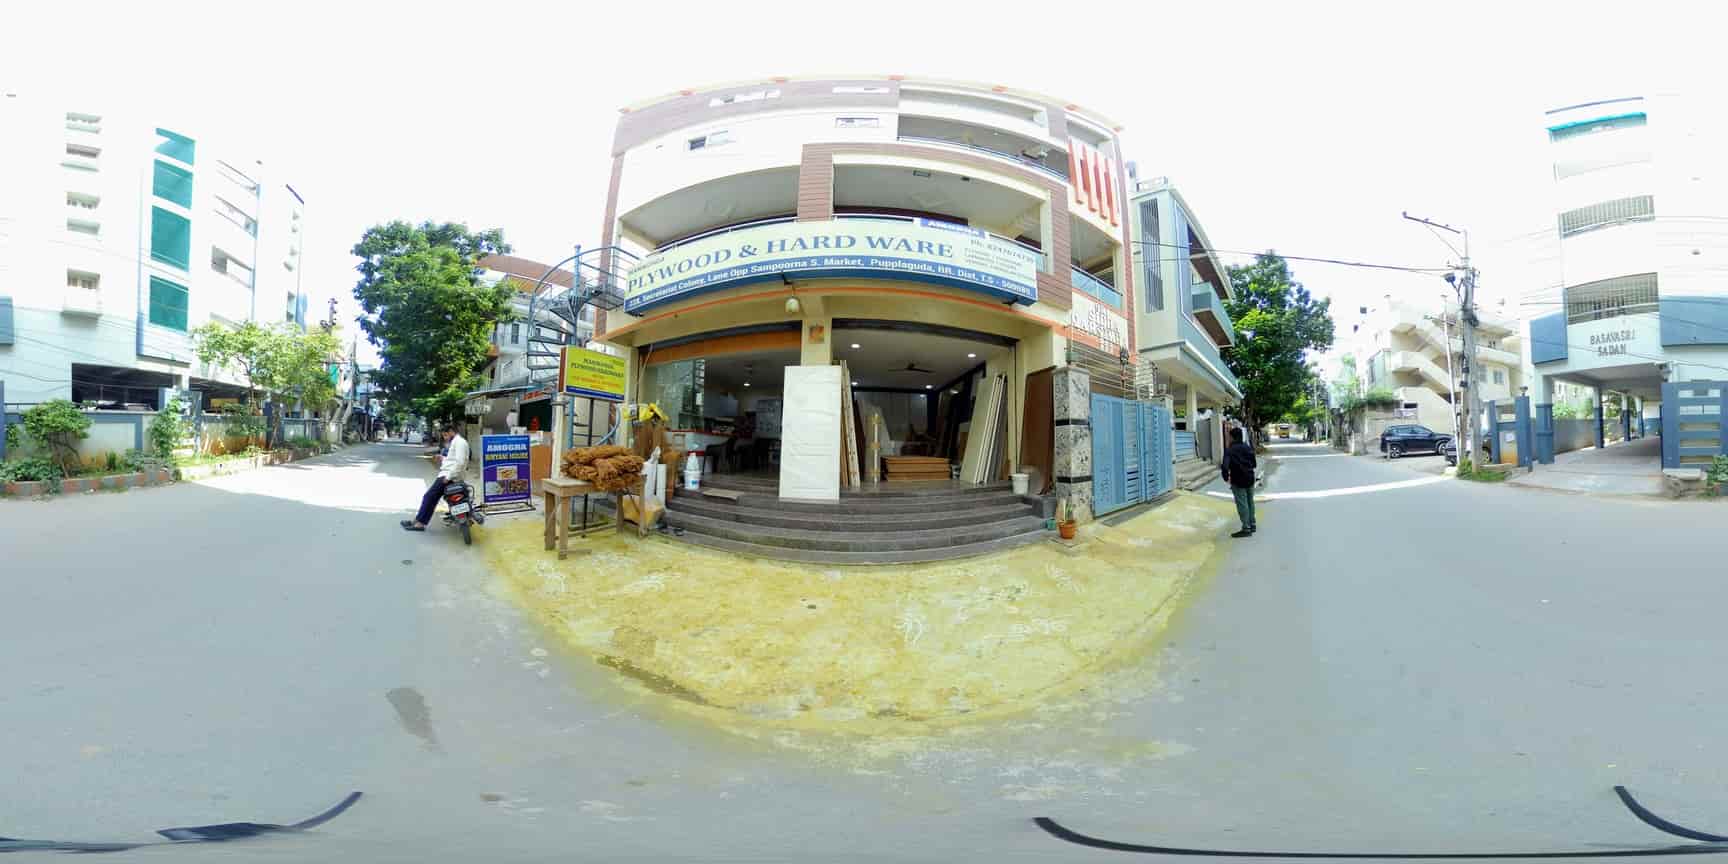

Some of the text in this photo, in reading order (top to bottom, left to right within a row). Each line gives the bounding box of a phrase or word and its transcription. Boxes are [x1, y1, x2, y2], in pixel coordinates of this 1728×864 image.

[628, 249, 731, 292] PLYWOOD
[738, 244, 758, 258] &
[767, 235, 856, 253] HARD
[866, 235, 953, 258] WARE
[707, 271, 728, 283] Lane
[729, 266, 748, 278] Opp
[750, 259, 808, 273] Sampoorna
[1597, 343, 1626, 356] SADAN
